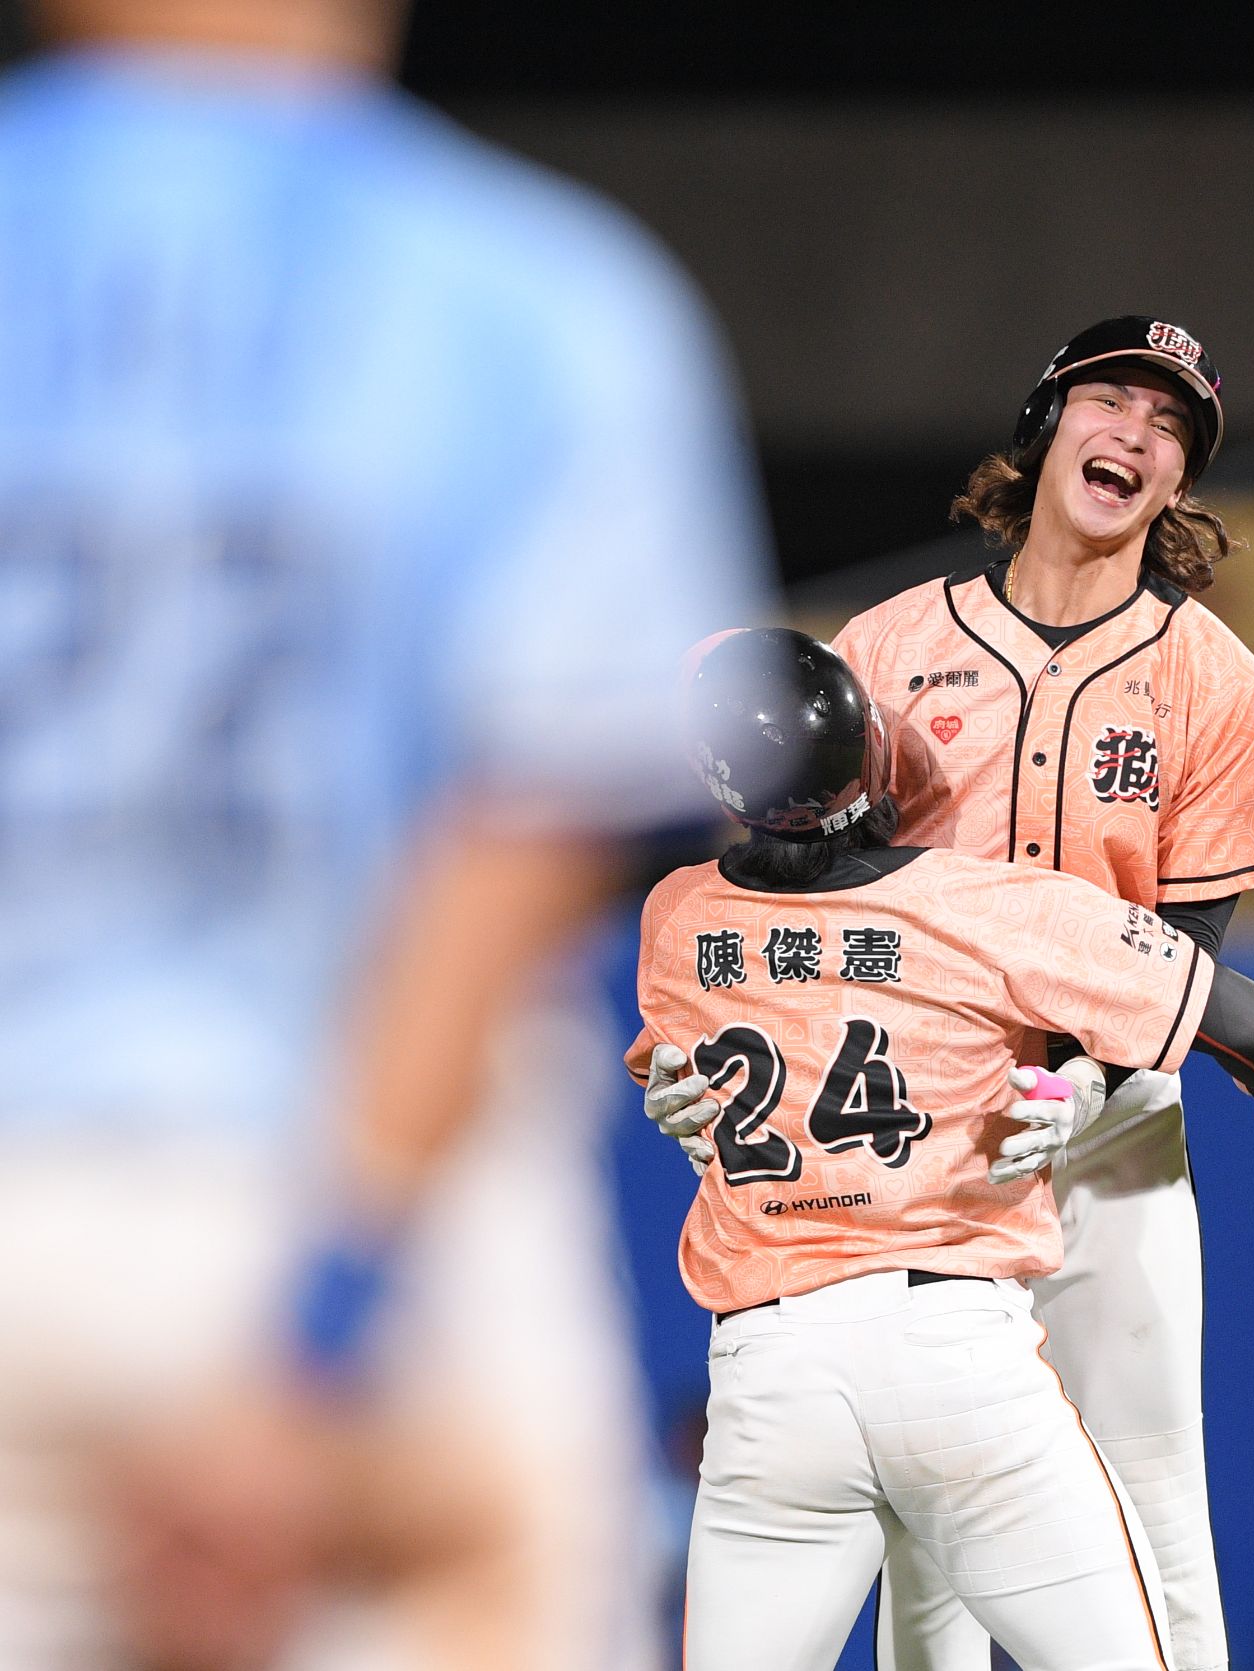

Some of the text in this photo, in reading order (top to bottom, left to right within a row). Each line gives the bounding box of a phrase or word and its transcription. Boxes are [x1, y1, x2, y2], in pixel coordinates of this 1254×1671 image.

[927, 670, 979, 688] 愛爾麗
[1124, 680, 1172, 719] 兆行
[820, 792, 870, 836] 輝葉
[696, 926, 902, 991] 陳傑憲
[690, 1014, 934, 1188] 24
[791, 1192, 872, 1212] HYUNDAI
